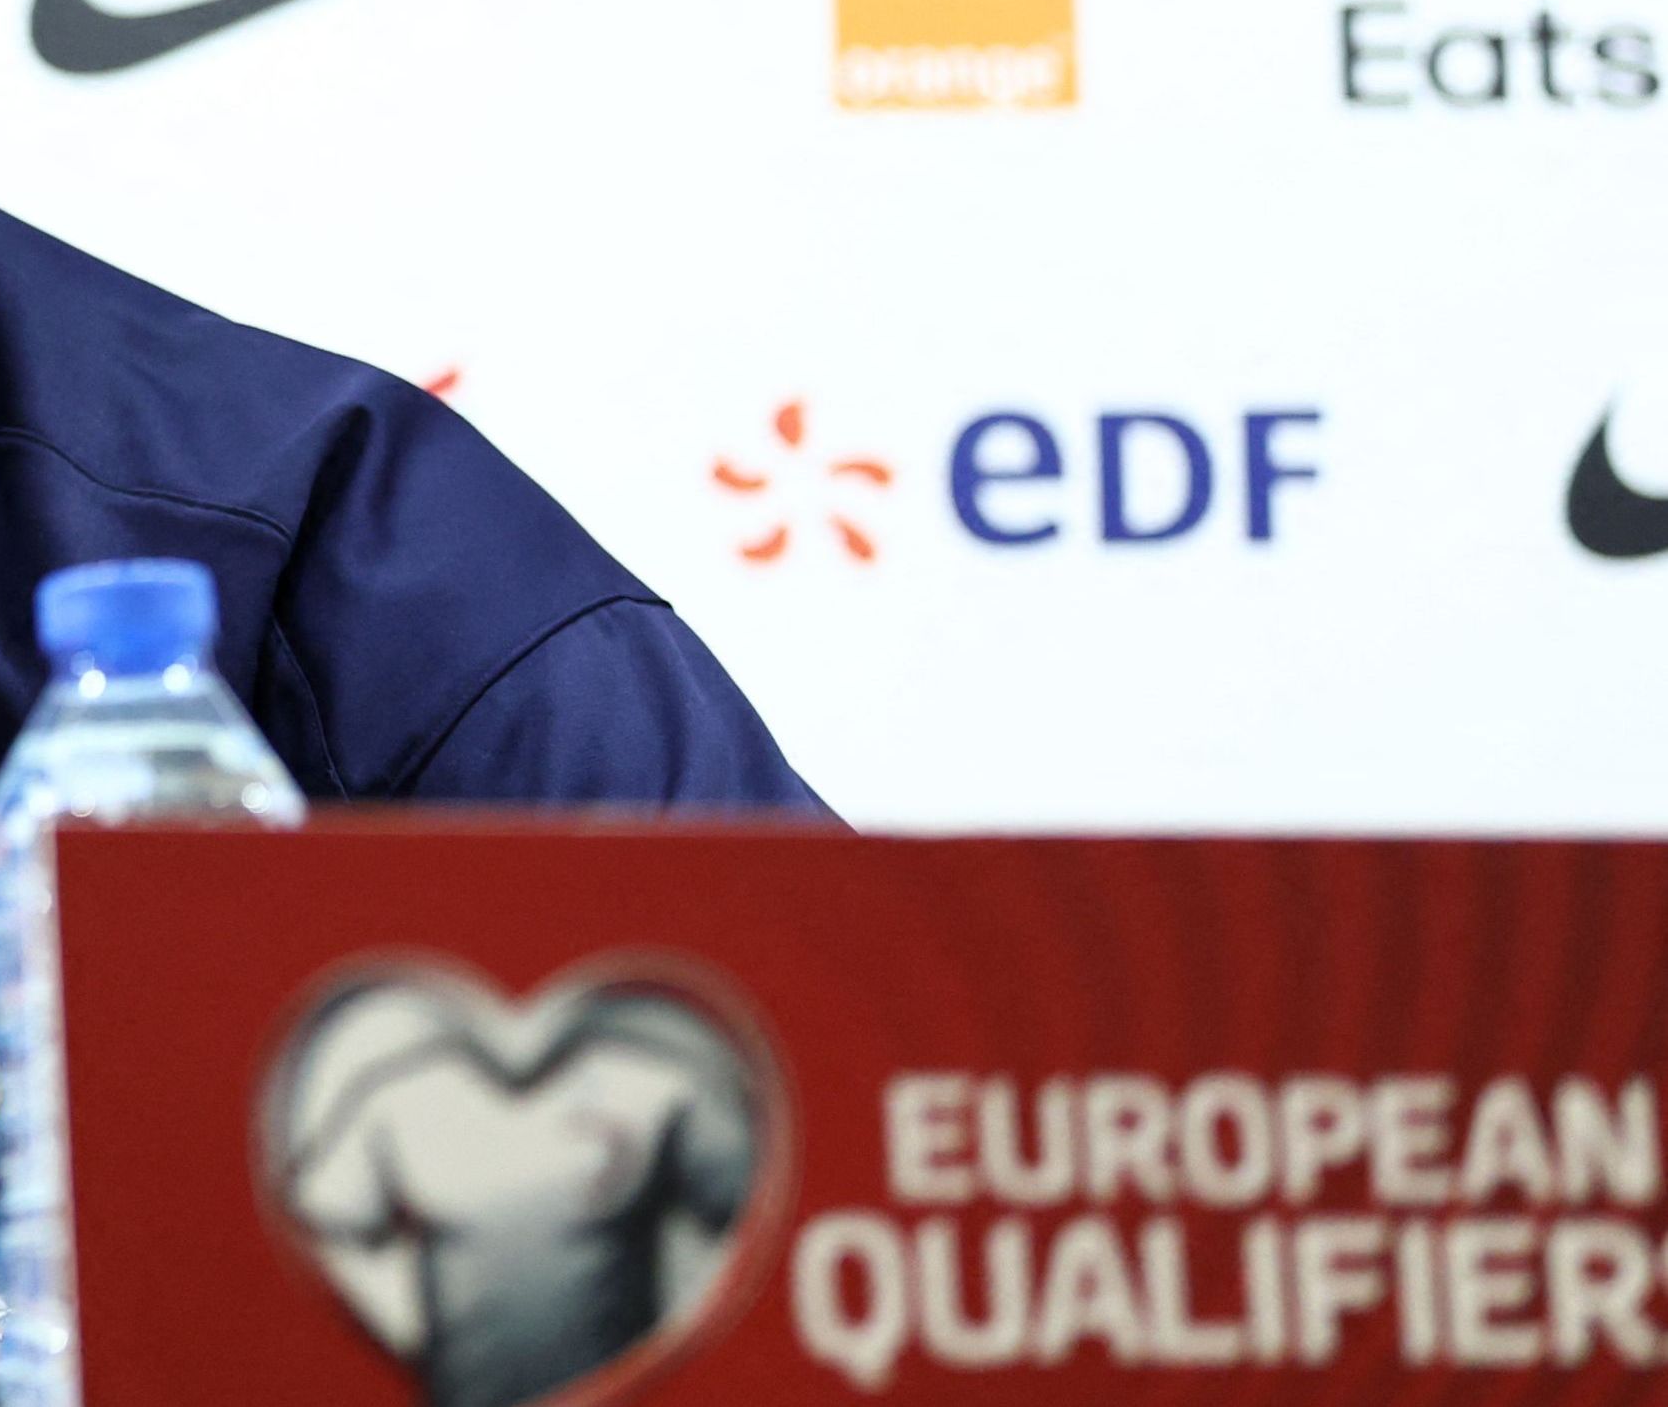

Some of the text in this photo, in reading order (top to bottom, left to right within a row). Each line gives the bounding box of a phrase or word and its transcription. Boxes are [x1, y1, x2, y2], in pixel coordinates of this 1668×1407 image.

[835, 42, 1065, 108] orange
[1338, 0, 1663, 107] Eats
[885, 1074, 1661, 1206] EUROPEAN
[793, 1208, 1668, 1392] QUALIFIER
